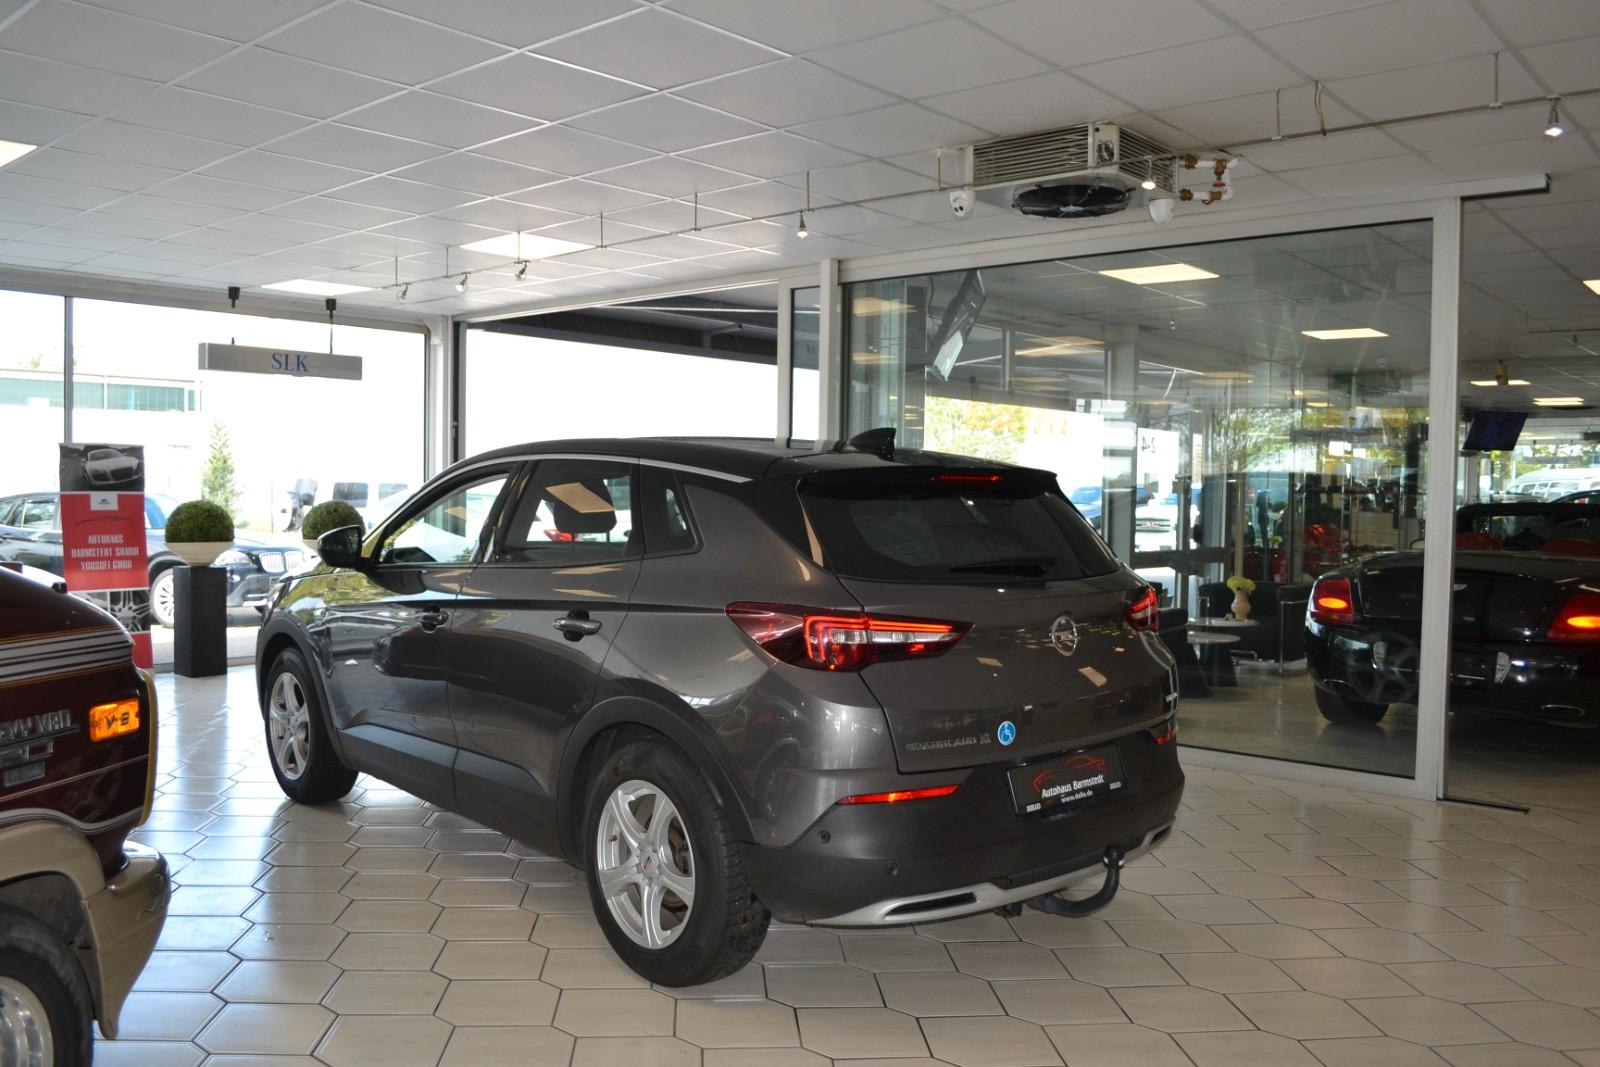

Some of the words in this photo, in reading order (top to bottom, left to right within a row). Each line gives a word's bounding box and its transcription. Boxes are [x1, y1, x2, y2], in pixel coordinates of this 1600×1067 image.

[271, 352, 308, 371] SLK
[1041, 783, 1072, 799] Autohaus
[1073, 774, 1105, 790] Barmstedt
